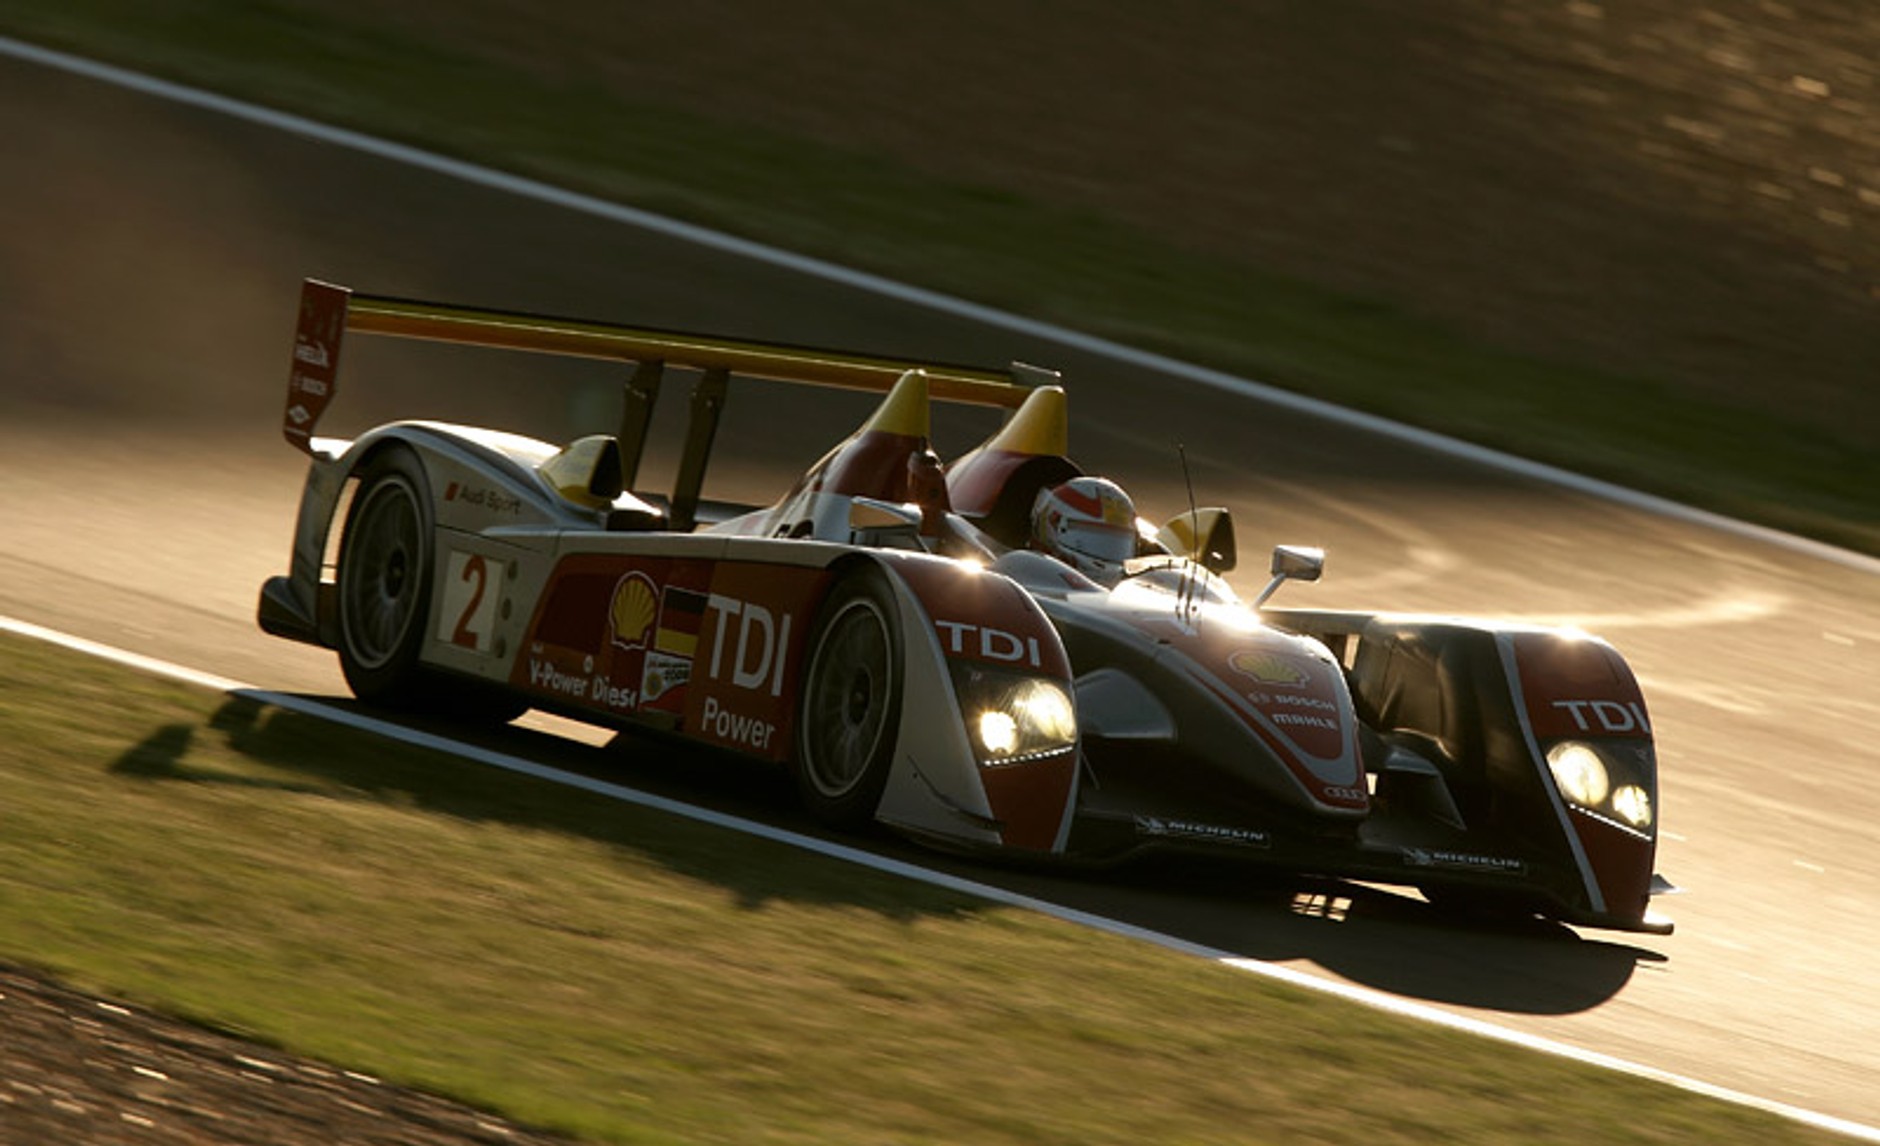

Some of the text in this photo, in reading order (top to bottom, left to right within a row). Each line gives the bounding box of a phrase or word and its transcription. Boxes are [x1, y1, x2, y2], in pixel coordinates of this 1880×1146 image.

[452, 554, 487, 650] 2
[707, 593, 792, 697] TDI
[935, 619, 1041, 668] TDI
[529, 656, 589, 697] V-Power
[702, 697, 775, 749] Power
[1552, 700, 1651, 735] TDI
[1168, 820, 1264, 841] MICHELIN
[1432, 851, 1521, 868] MICHELIN
